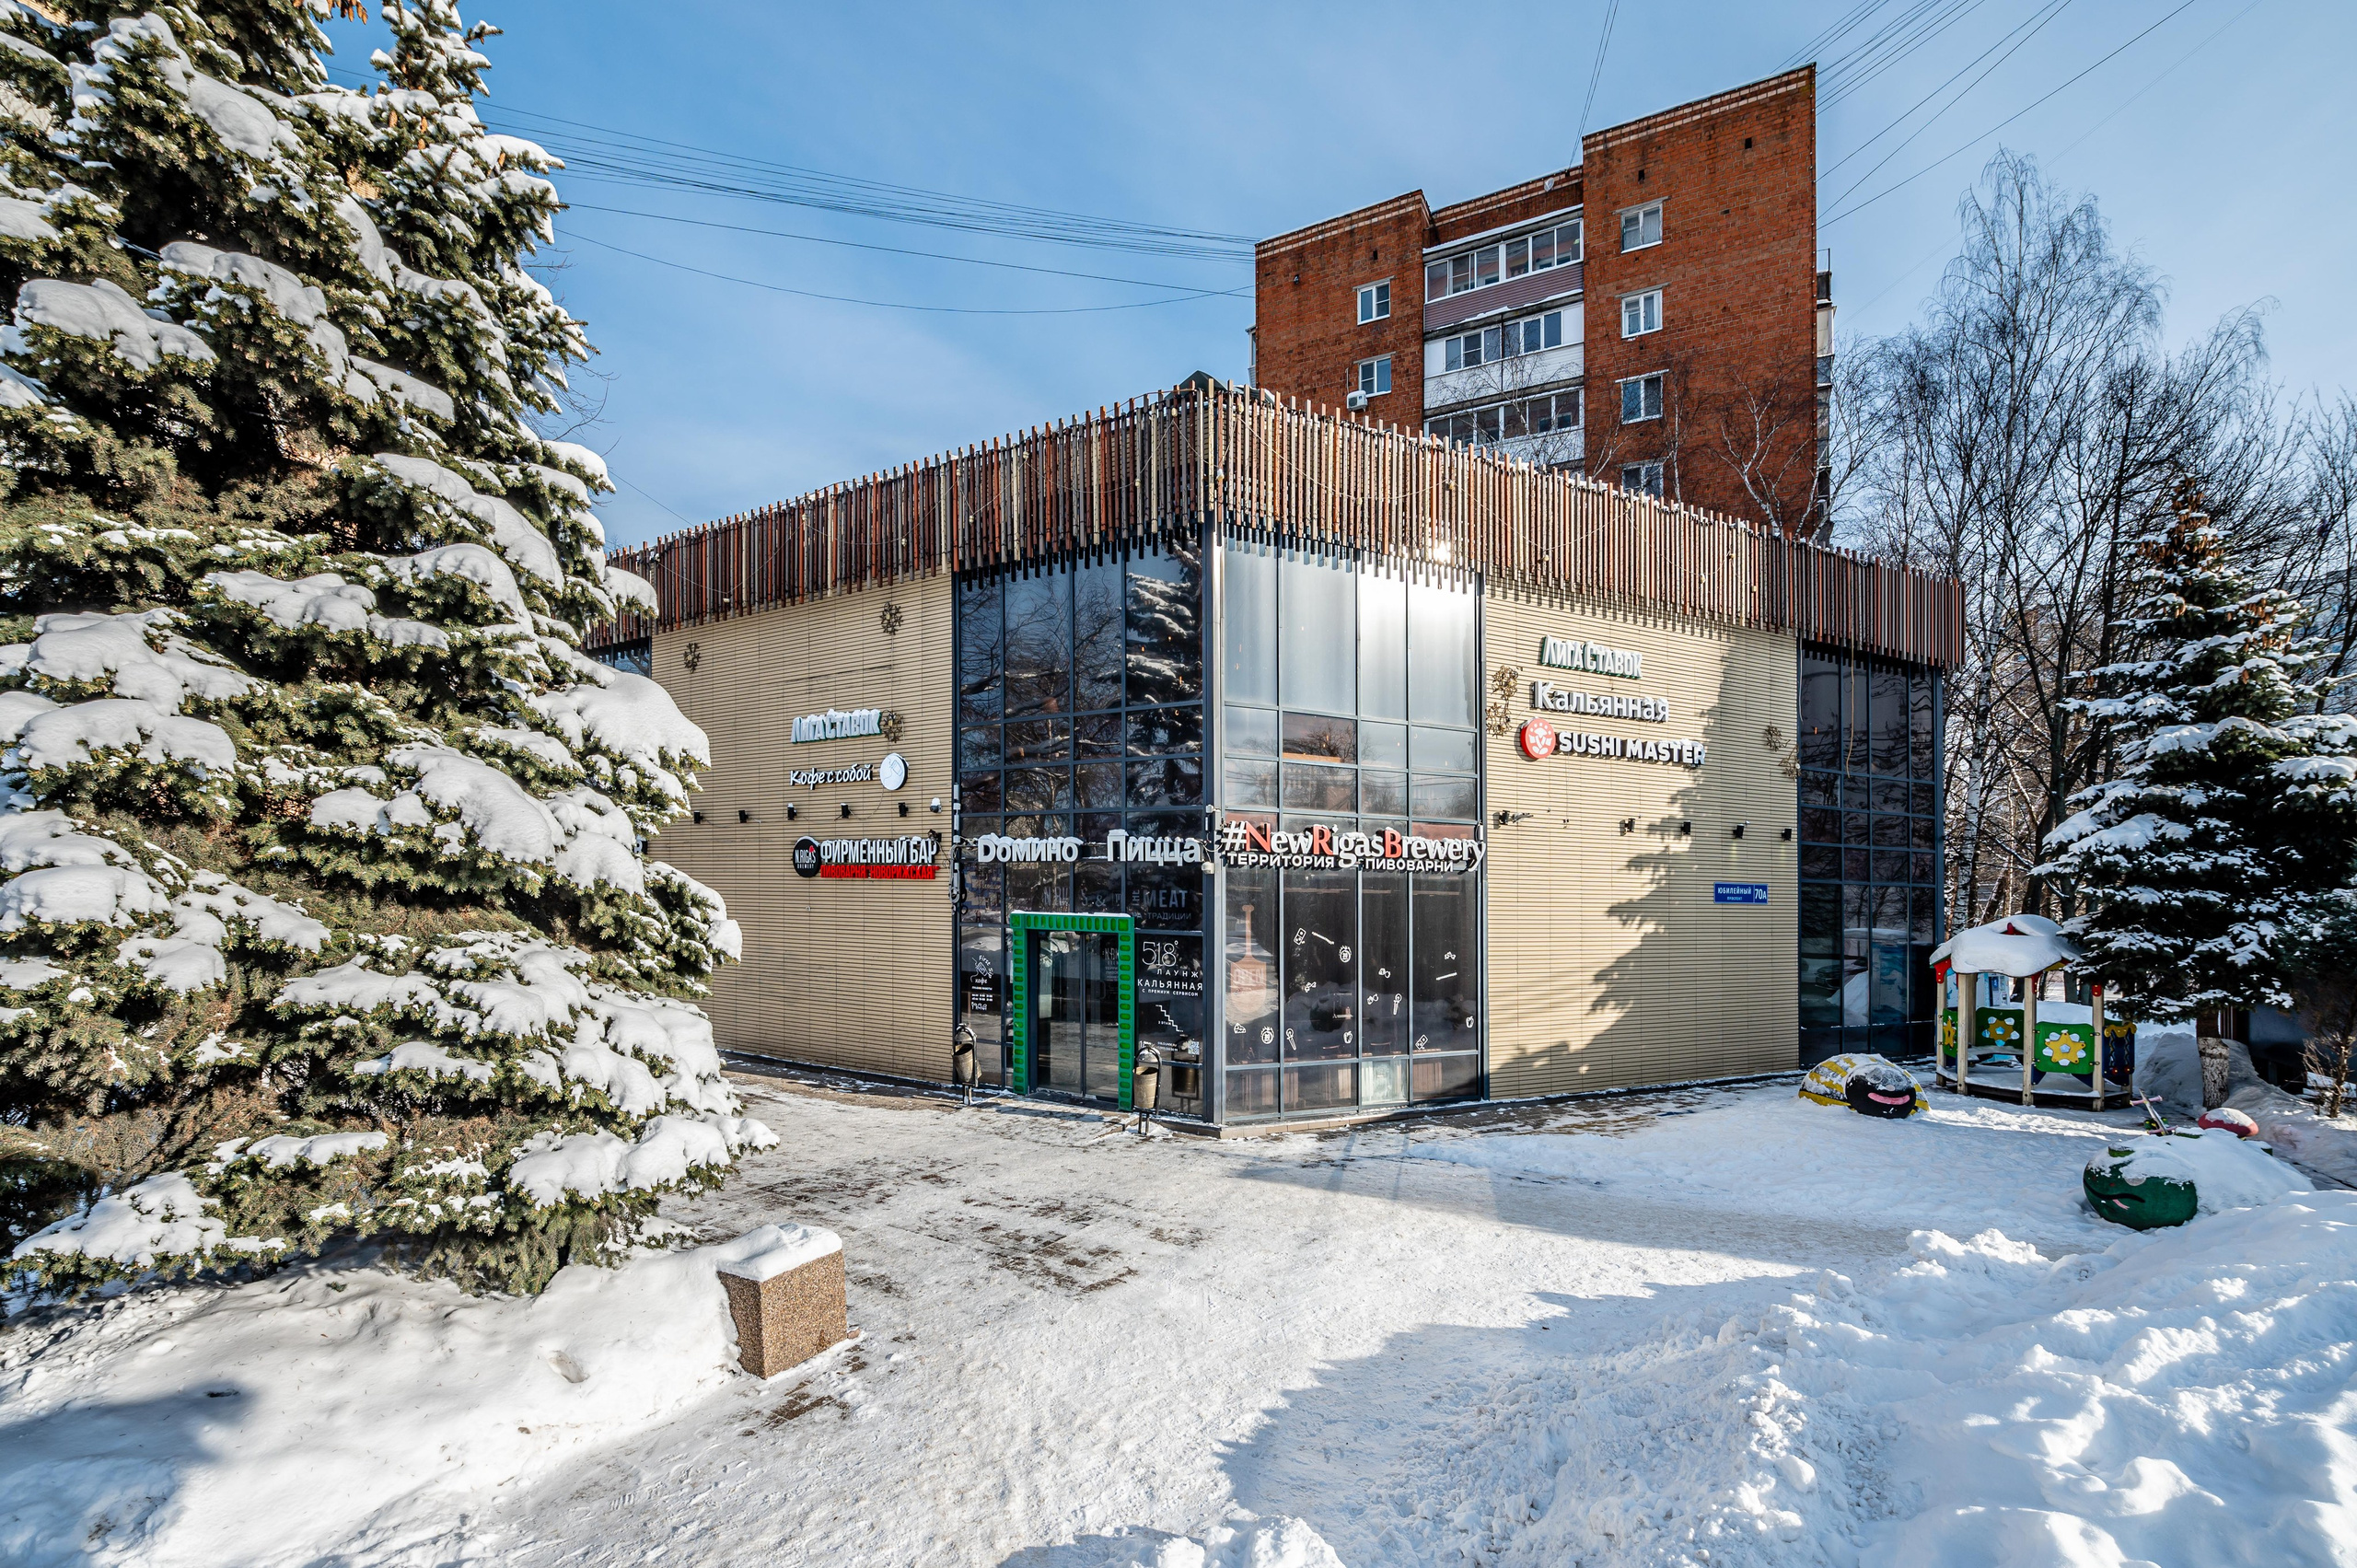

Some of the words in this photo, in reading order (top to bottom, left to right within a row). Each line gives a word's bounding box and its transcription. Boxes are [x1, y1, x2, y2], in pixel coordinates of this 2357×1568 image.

[1533, 680, 1669, 722] Кальянная
[1559, 732, 1621, 757] SUSHI
[1625, 738, 1705, 765] MASTER
[790, 767, 825, 790] Кофе
[827, 771, 834, 784] с
[836, 763, 872, 784] собой
[820, 837, 908, 864] ФИРМЕННЫЙ
[909, 837, 937, 864] БАР
[1107, 833, 1203, 866] Пицца
[1221, 819, 1486, 872] #NewRigasBrewery
[820, 865, 866, 878] ПИВОВАРНЯ
[1226, 852, 1335, 868] ТЕРРИТОРИЯ
[1364, 857, 1454, 872] ПИВОВАРНИ
[1143, 889, 1189, 908] MEAT
[1717, 886, 1752, 895] ЮБИЛЕЙНЫЙ
[1137, 978, 1203, 991] КАЛЬЯННАЯ
[1156, 968, 1199, 979] ЛАУНЖ
